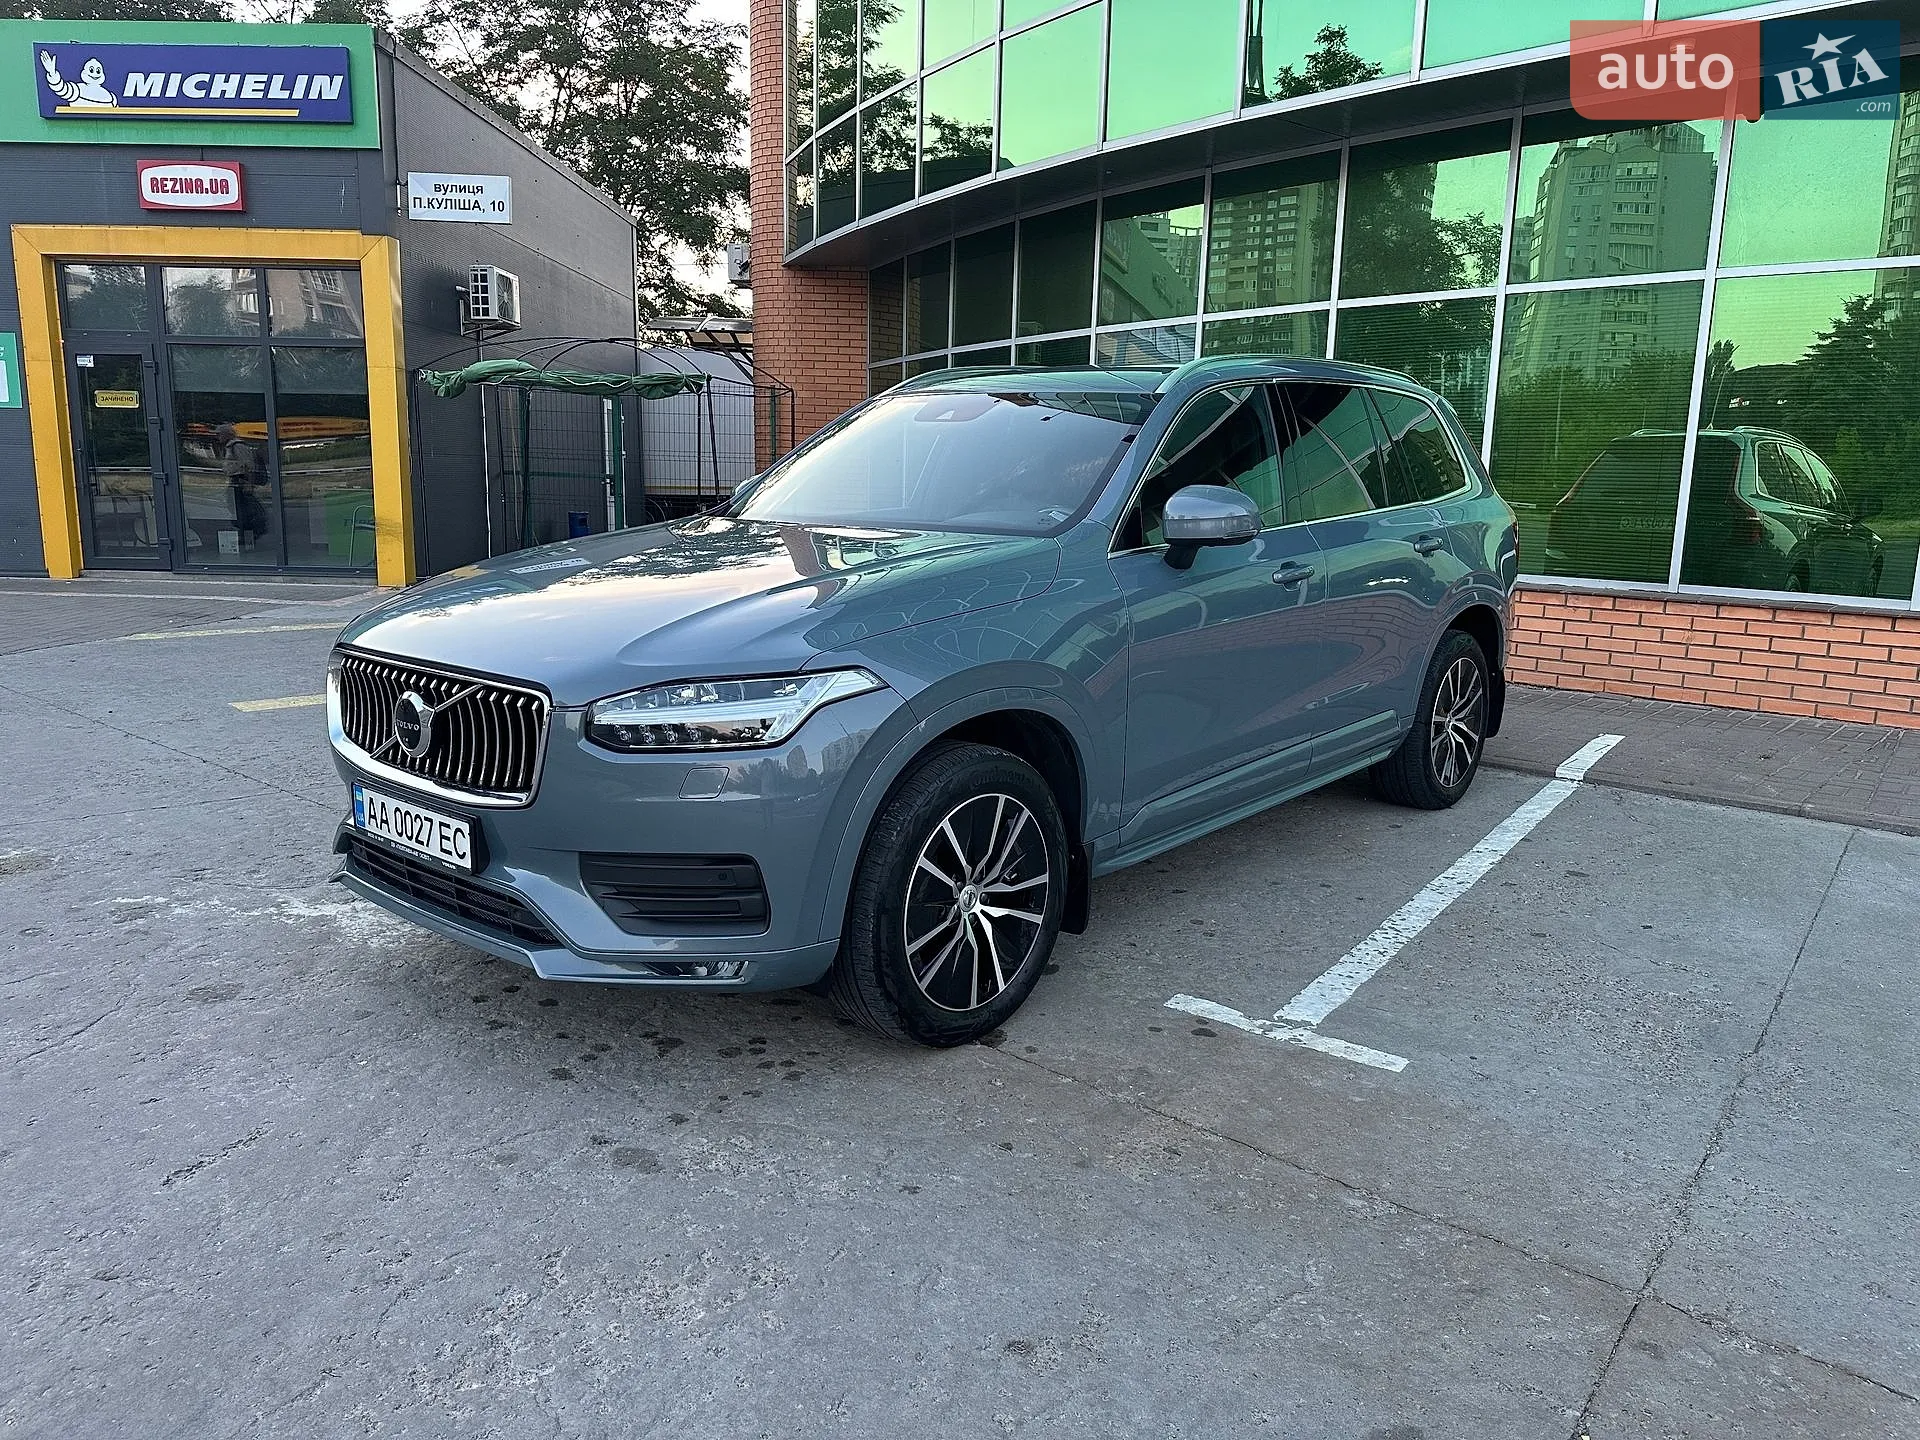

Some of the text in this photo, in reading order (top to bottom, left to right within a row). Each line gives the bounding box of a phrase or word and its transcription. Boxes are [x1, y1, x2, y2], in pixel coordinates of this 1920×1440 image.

[122, 72, 344, 100] MICHELIN
[150, 176, 230, 195] REZINA.UA
[433, 183, 484, 196] вулиця
[413, 196, 505, 213] П.КУЛІША, 10
[396, 718, 420, 731] VOLVO
[368, 796, 391, 834] AA
[394, 807, 434, 848] 0027
[439, 820, 467, 860] EC
